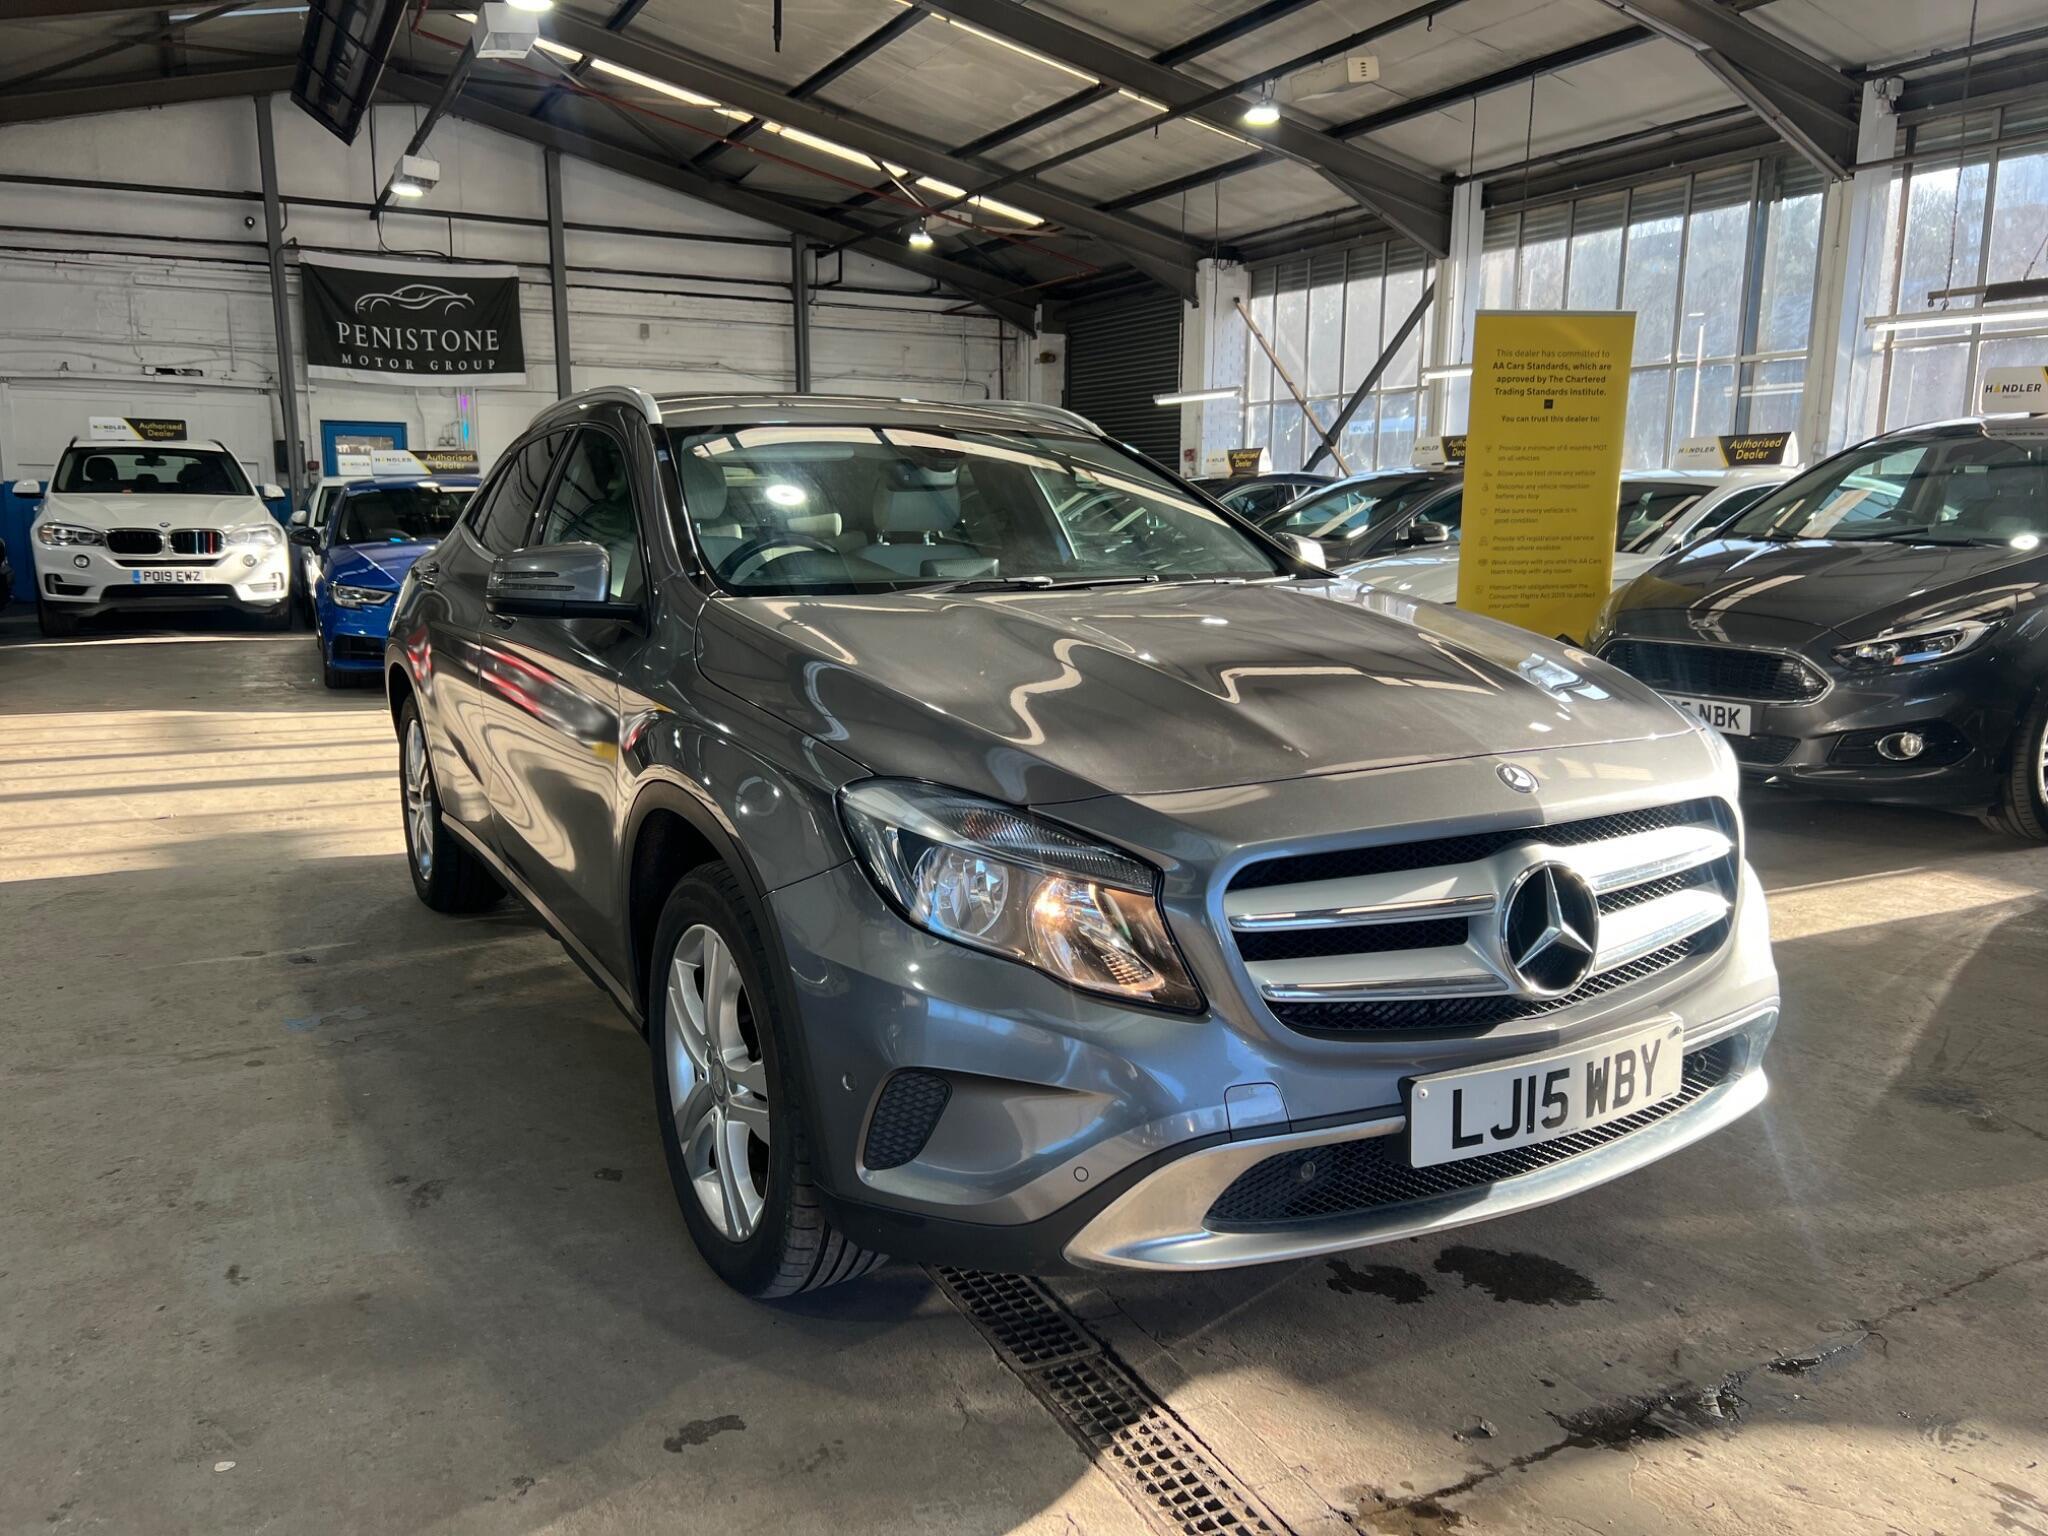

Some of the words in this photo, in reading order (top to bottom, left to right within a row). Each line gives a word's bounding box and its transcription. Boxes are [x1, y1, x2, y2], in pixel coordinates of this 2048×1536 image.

[336, 321, 500, 352] PENISTONE
[1497, 349, 1512, 357] This
[1514, 349, 1538, 357] dealer
[1541, 349, 1555, 357] has
[1557, 349, 1599, 357] committed
[1602, 349, 1610, 357] to
[341, 353, 414, 370] MOTOR
[430, 359, 495, 371] GROUP
[1493, 362, 1504, 370] AA
[1506, 362, 1524, 370] Cars
[1527, 362, 1570, 371] Standards,
[1572, 362, 1597, 370] which
[1496, 376, 1535, 384] approved
[1537, 376, 1547, 384] by
[1494, 388, 1524, 397] Trading
[1527, 388, 1567, 396] Standards
[1570, 388, 1606, 396] Institute.
[1985, 382, 2042, 393] HANDLER
[139, 422, 182, 430] Authorised
[1729, 436, 1783, 449] Authorised
[1735, 449, 1768, 460] Dealer
[436, 461, 465, 469] Dealer
[176, 571, 201, 582] EWZ
[1699, 704, 1740, 729] NBK
[1452, 1067, 1570, 1150] LJ15
[1586, 1039, 1662, 1119] WBY
